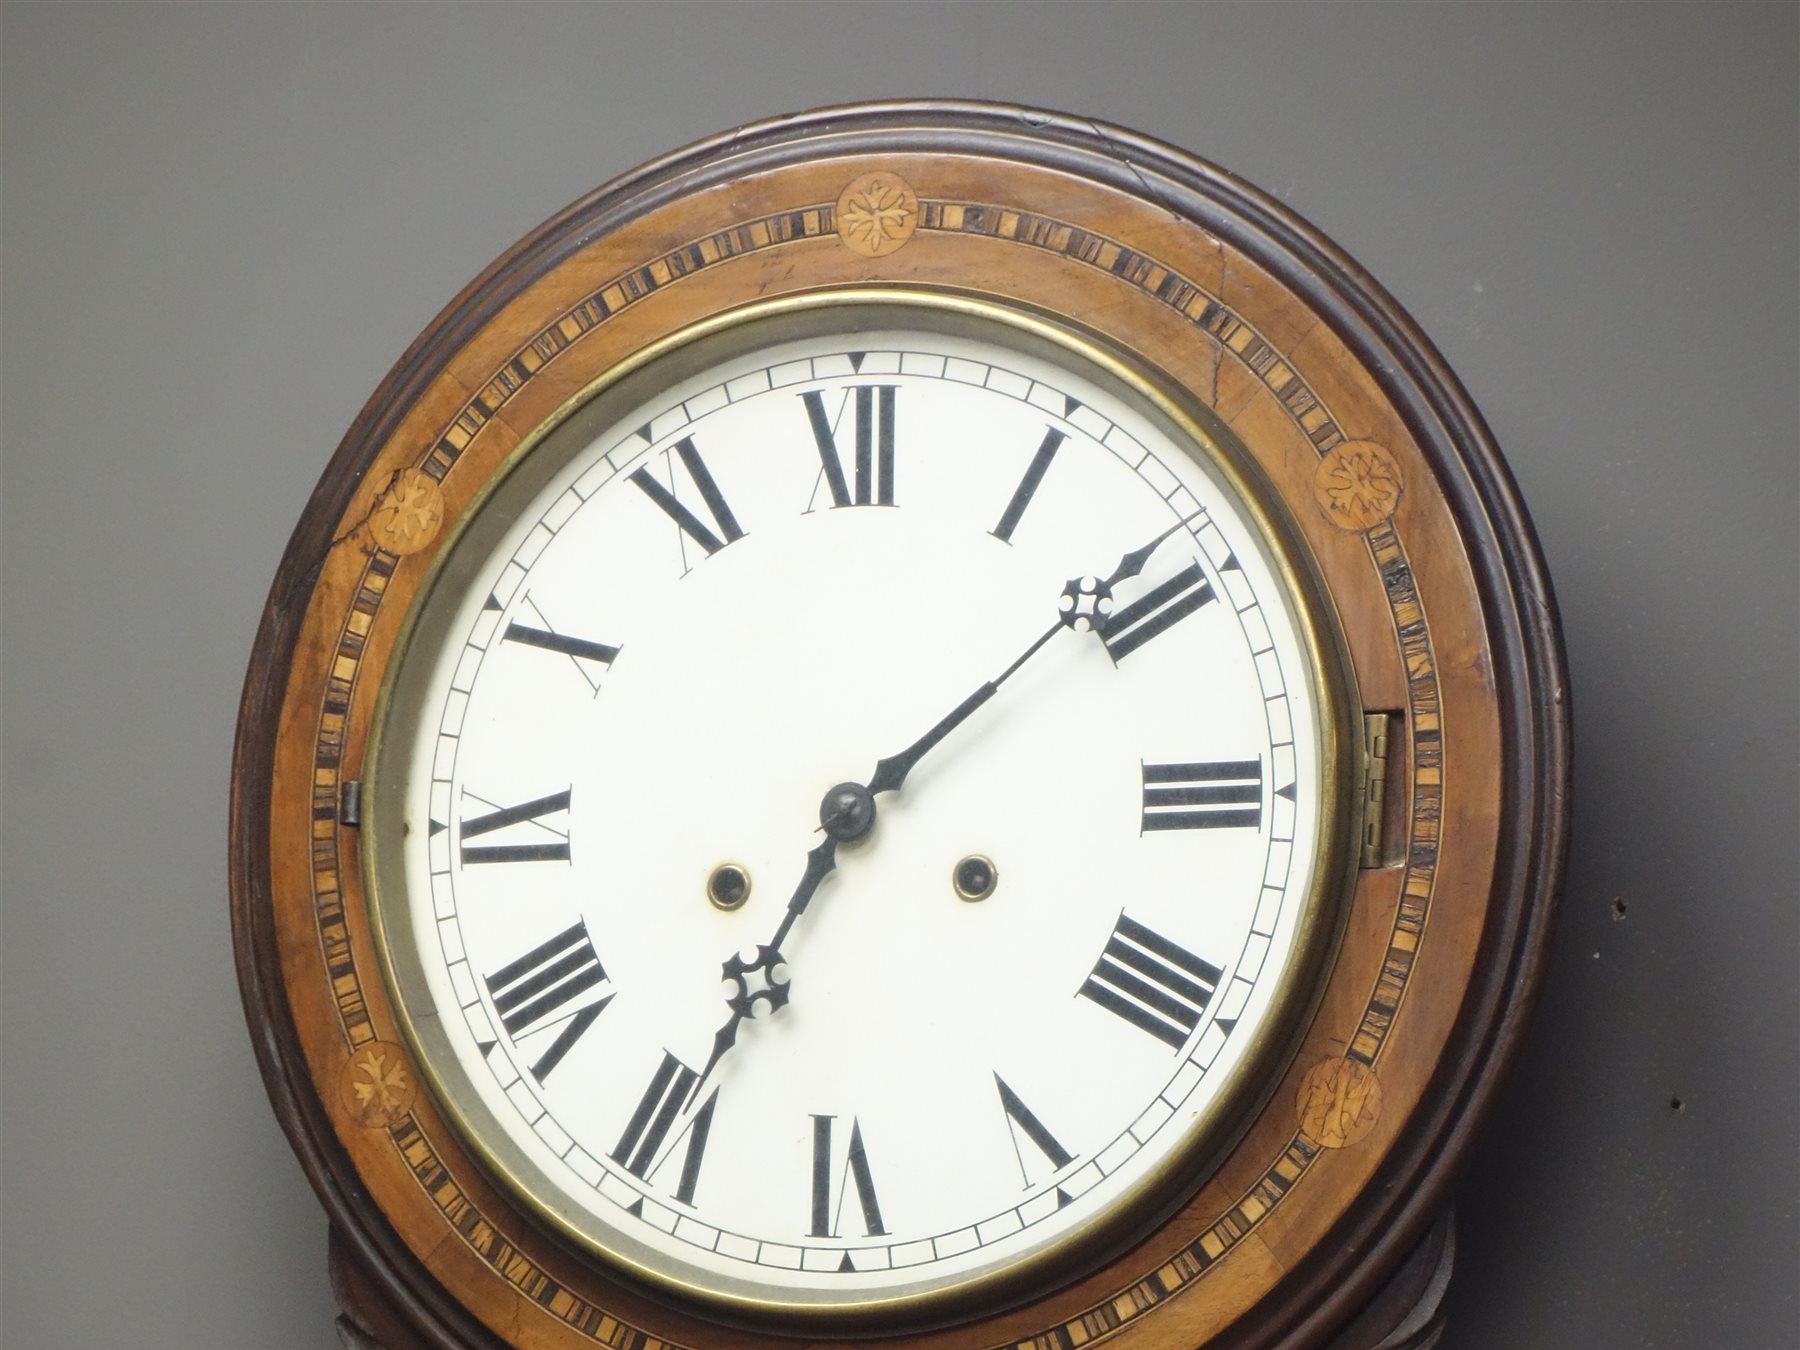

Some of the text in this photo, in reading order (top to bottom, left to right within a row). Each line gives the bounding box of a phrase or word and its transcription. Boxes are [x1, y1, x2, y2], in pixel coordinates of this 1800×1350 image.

[624, 433, 750, 579] XI
[796, 385, 902, 515] XII
[987, 424, 1072, 546] I
[500, 589, 624, 699] X
[1094, 556, 1220, 669] II
[460, 784, 572, 870] IX
[1141, 753, 1262, 837] III
[483, 914, 617, 1089] VIII
[1074, 907, 1227, 1057] IIII
[606, 1048, 720, 1209] VII
[805, 1114, 892, 1238] VI
[993, 1070, 1080, 1191] V
